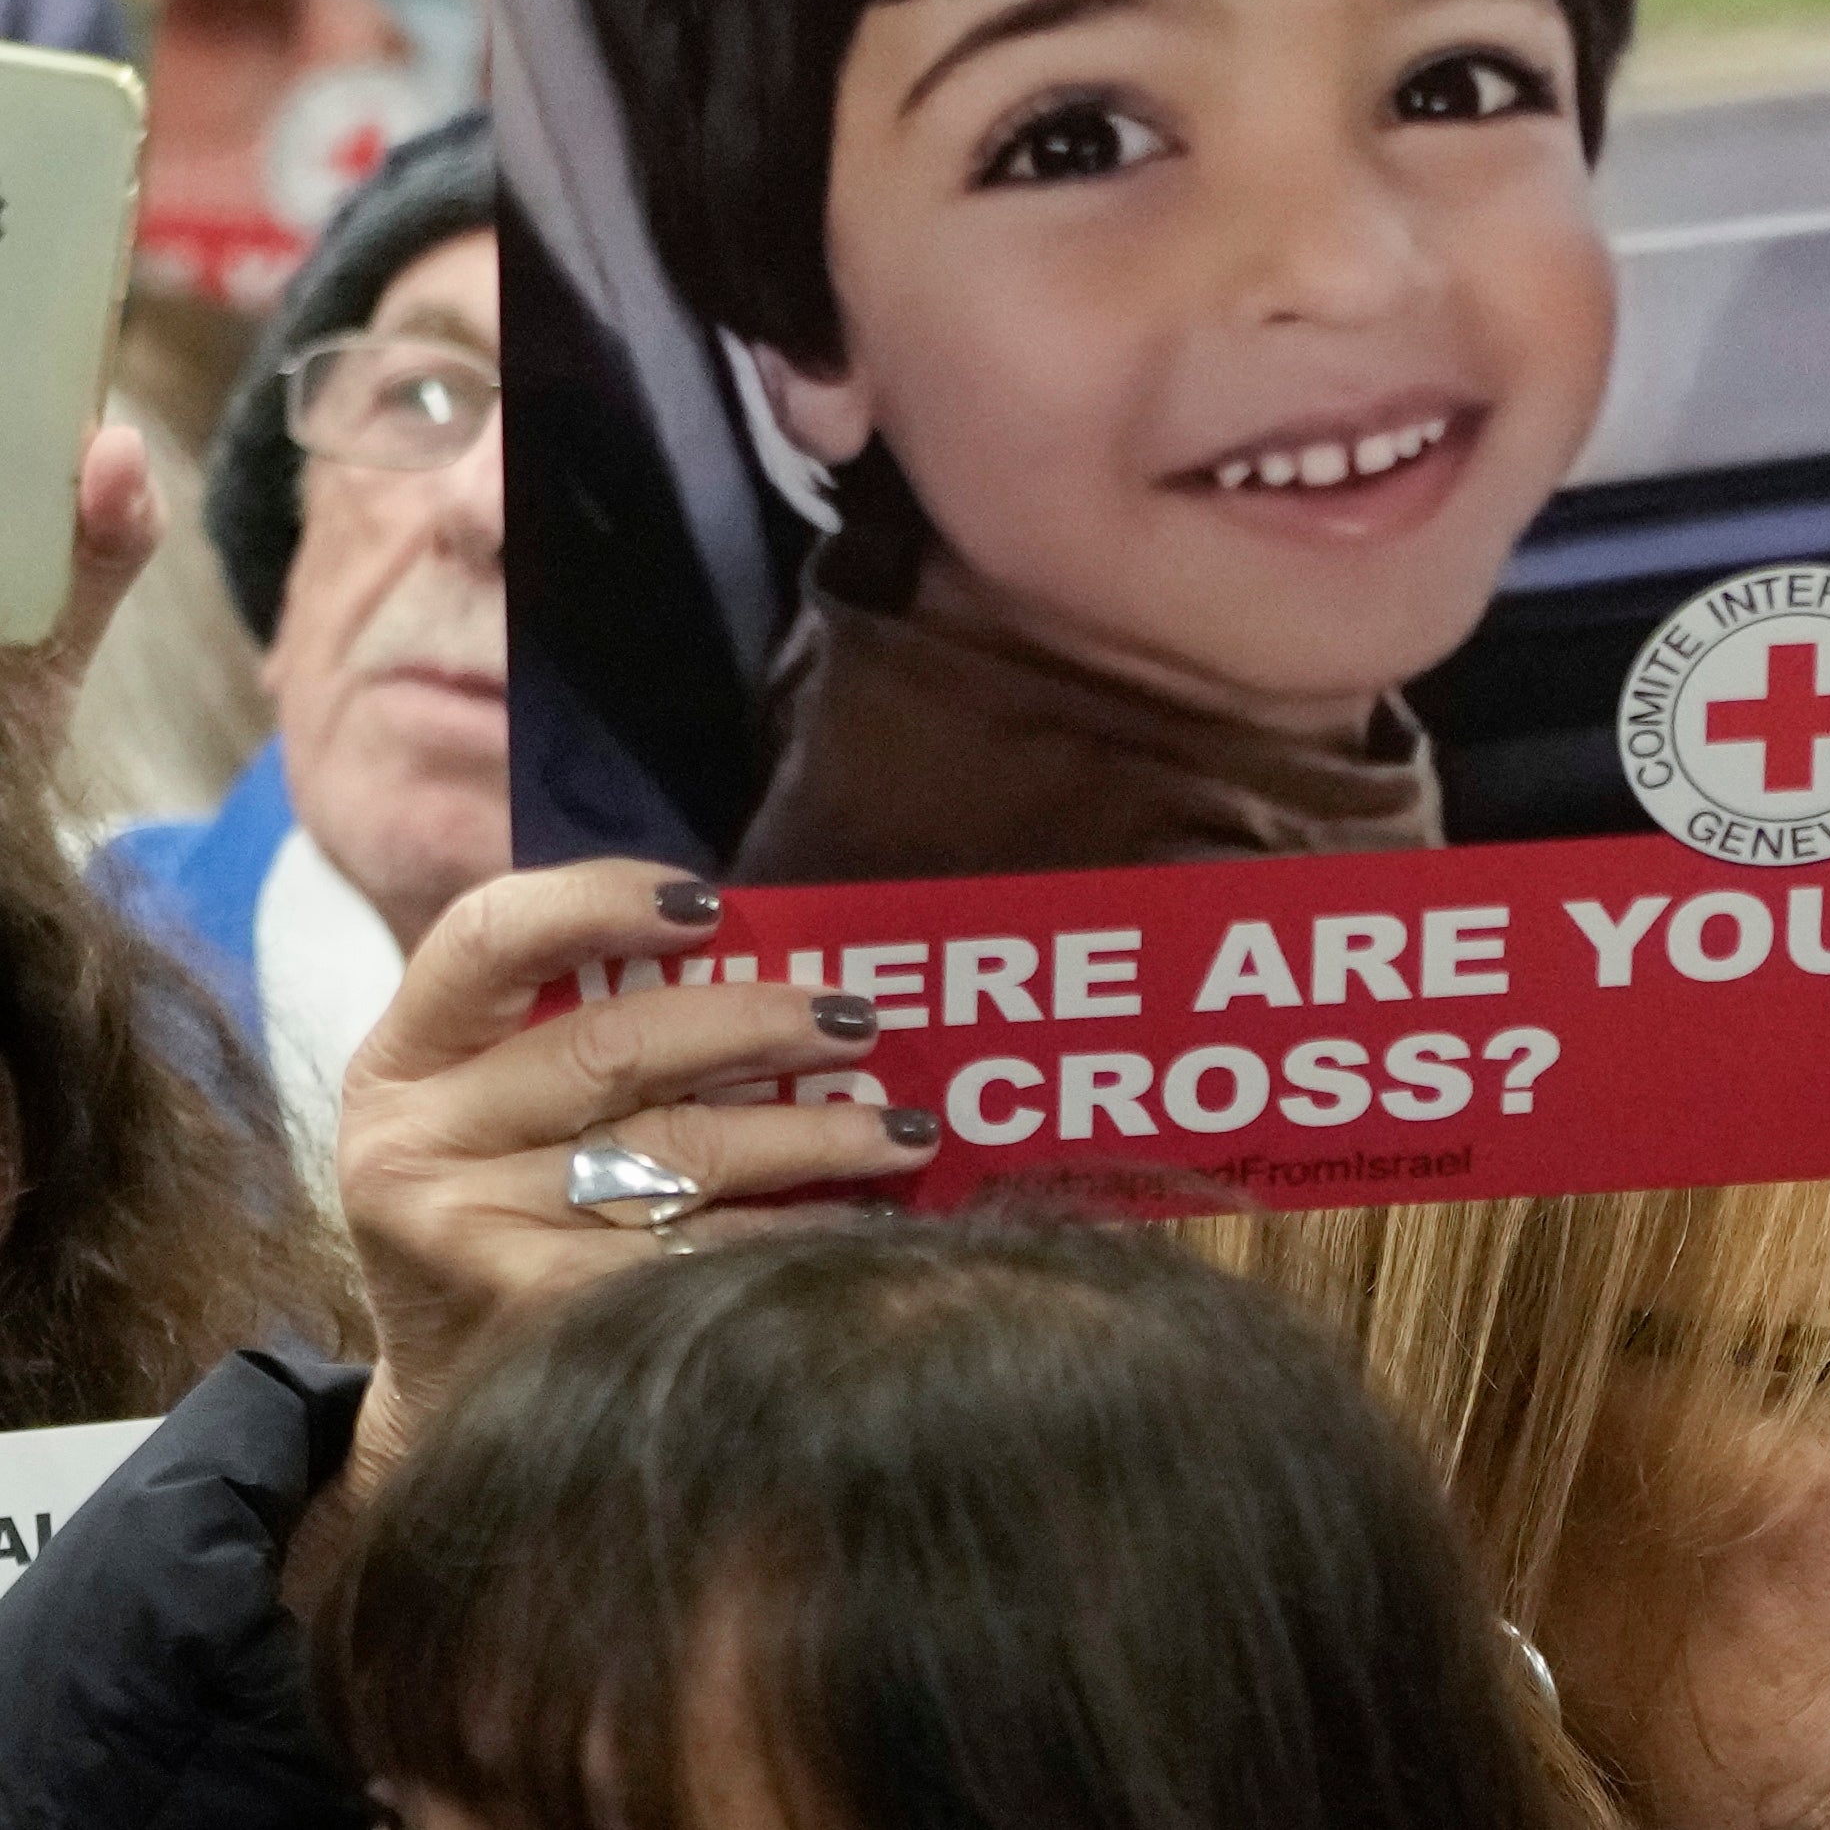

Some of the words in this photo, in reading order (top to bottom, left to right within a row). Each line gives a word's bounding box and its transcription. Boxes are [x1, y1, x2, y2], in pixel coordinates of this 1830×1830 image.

[1626, 623, 1704, 791] COMITE
[1193, 905, 1512, 1014] ARE
[943, 1027, 1563, 1146] CROSS?
